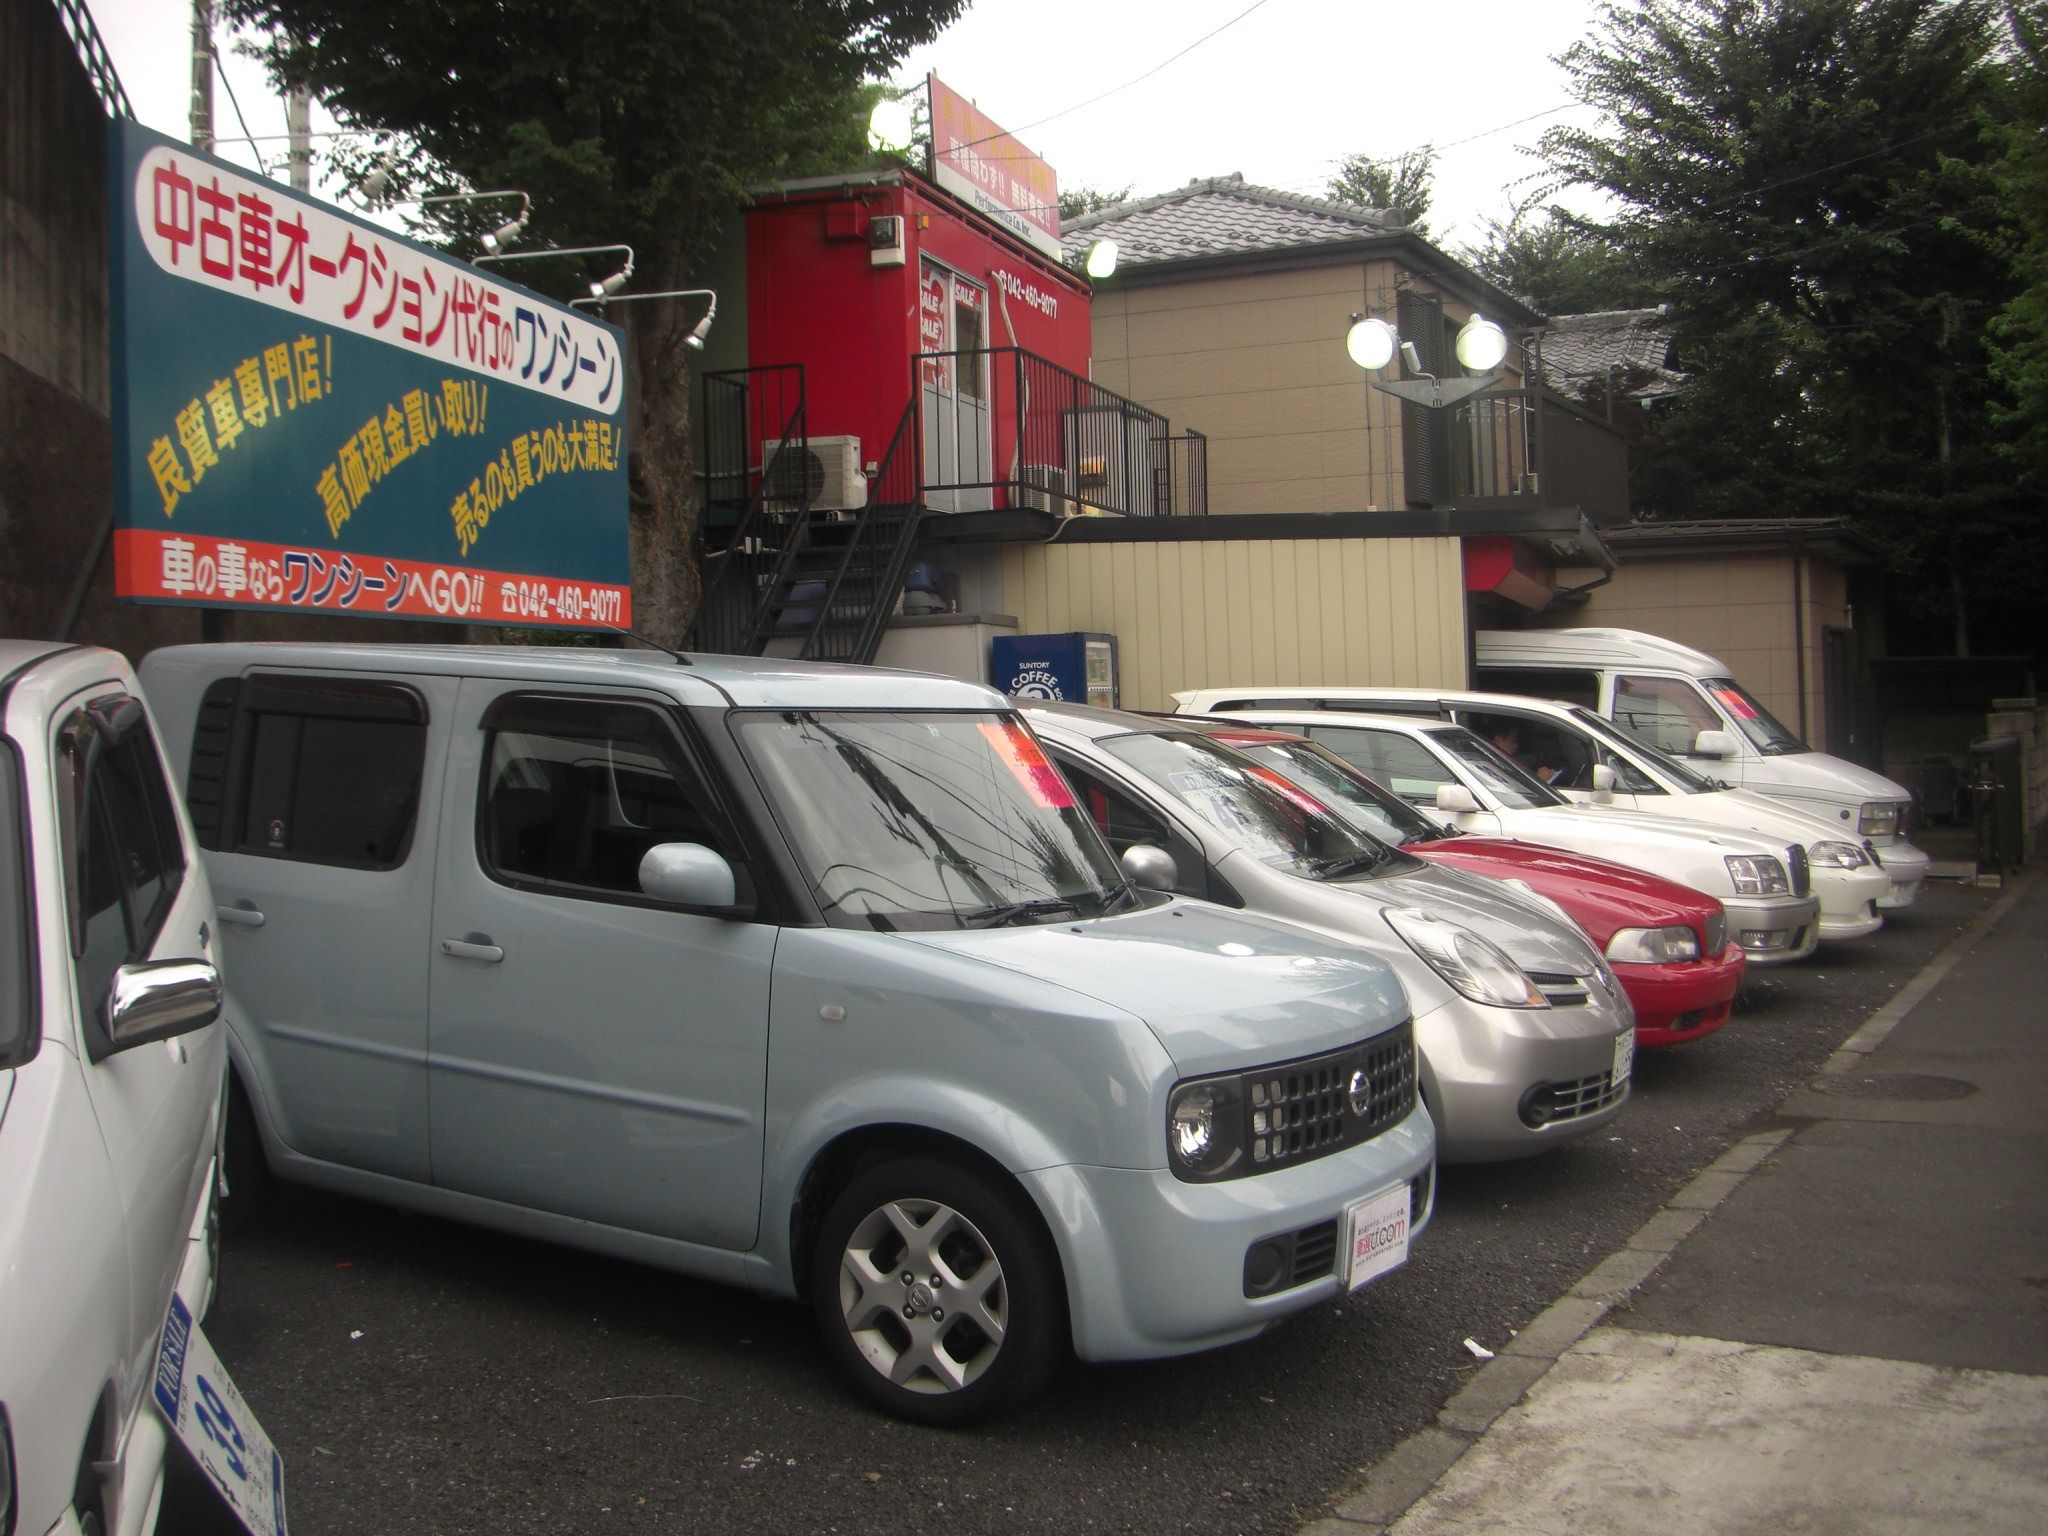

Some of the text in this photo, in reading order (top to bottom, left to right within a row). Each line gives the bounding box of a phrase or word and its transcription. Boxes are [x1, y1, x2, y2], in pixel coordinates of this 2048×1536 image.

[153, 159, 616, 405] 中古車オークション代行のワンシーン
[1007, 273, 1058, 320] 042-460-9077
[147, 334, 333, 519] 良質車専門店!
[315, 379, 488, 540] 高価現金買い取り!
[449, 419, 621, 557] 売るのも買うのも大満足!
[1011, 671, 1058, 689] COFFEE
[1019, 662, 1051, 670] SUNTORY
[194, 1373, 247, 1482] 39
